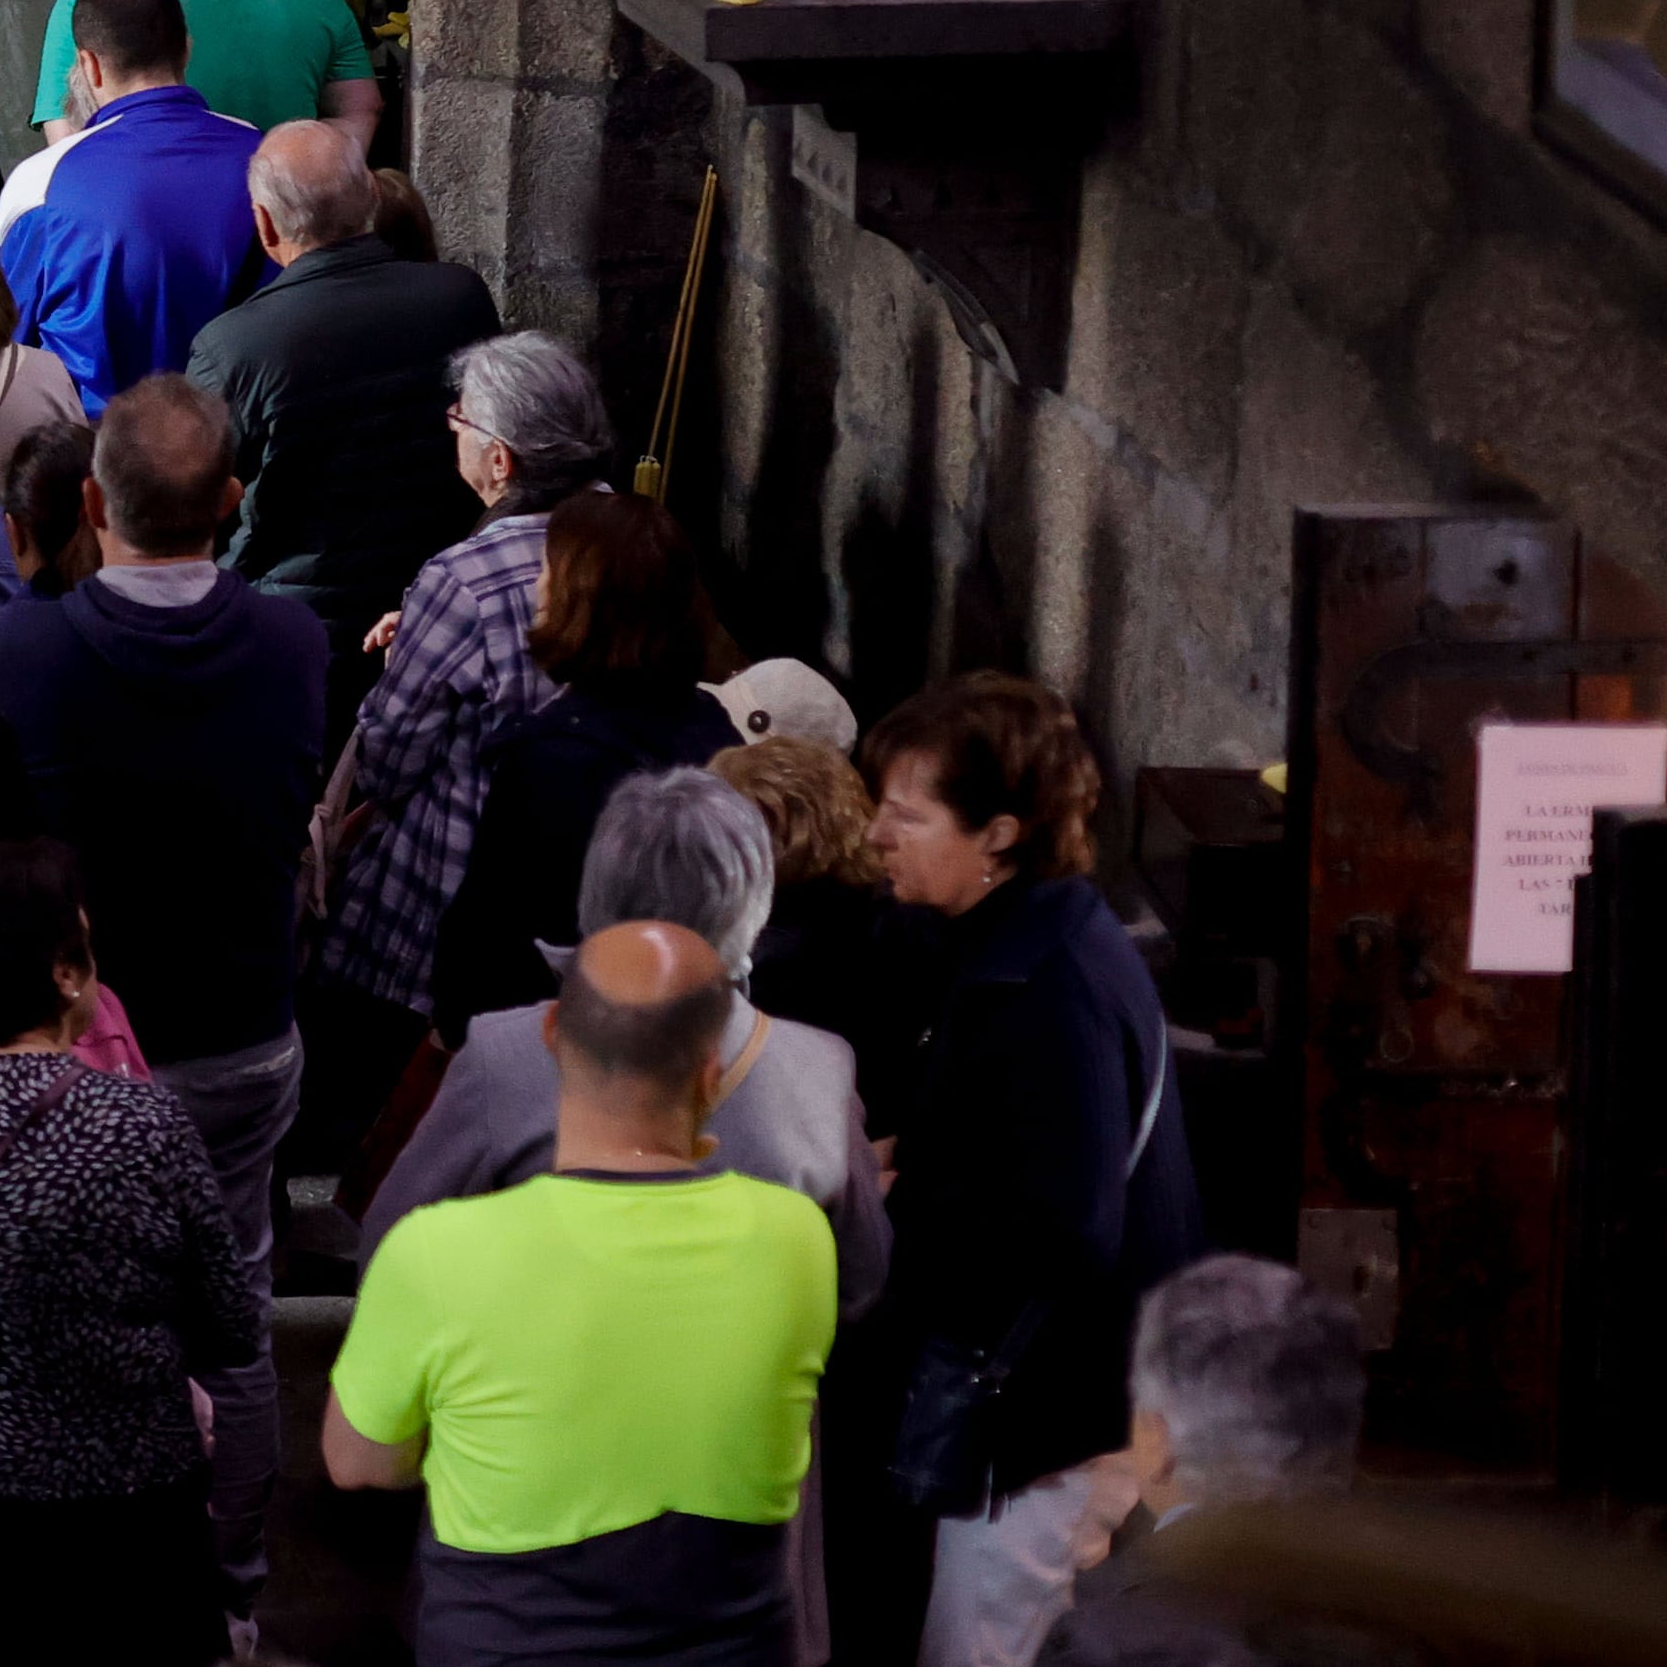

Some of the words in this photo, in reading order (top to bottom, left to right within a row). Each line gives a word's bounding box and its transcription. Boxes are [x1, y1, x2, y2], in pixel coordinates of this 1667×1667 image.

[1526, 805, 1548, 817] LA
[1552, 805, 1593, 817] ERM
[1505, 829, 1592, 842] PERMANE
[1503, 854, 1576, 866] ABIERTA
[1539, 903, 1572, 915] TAR
